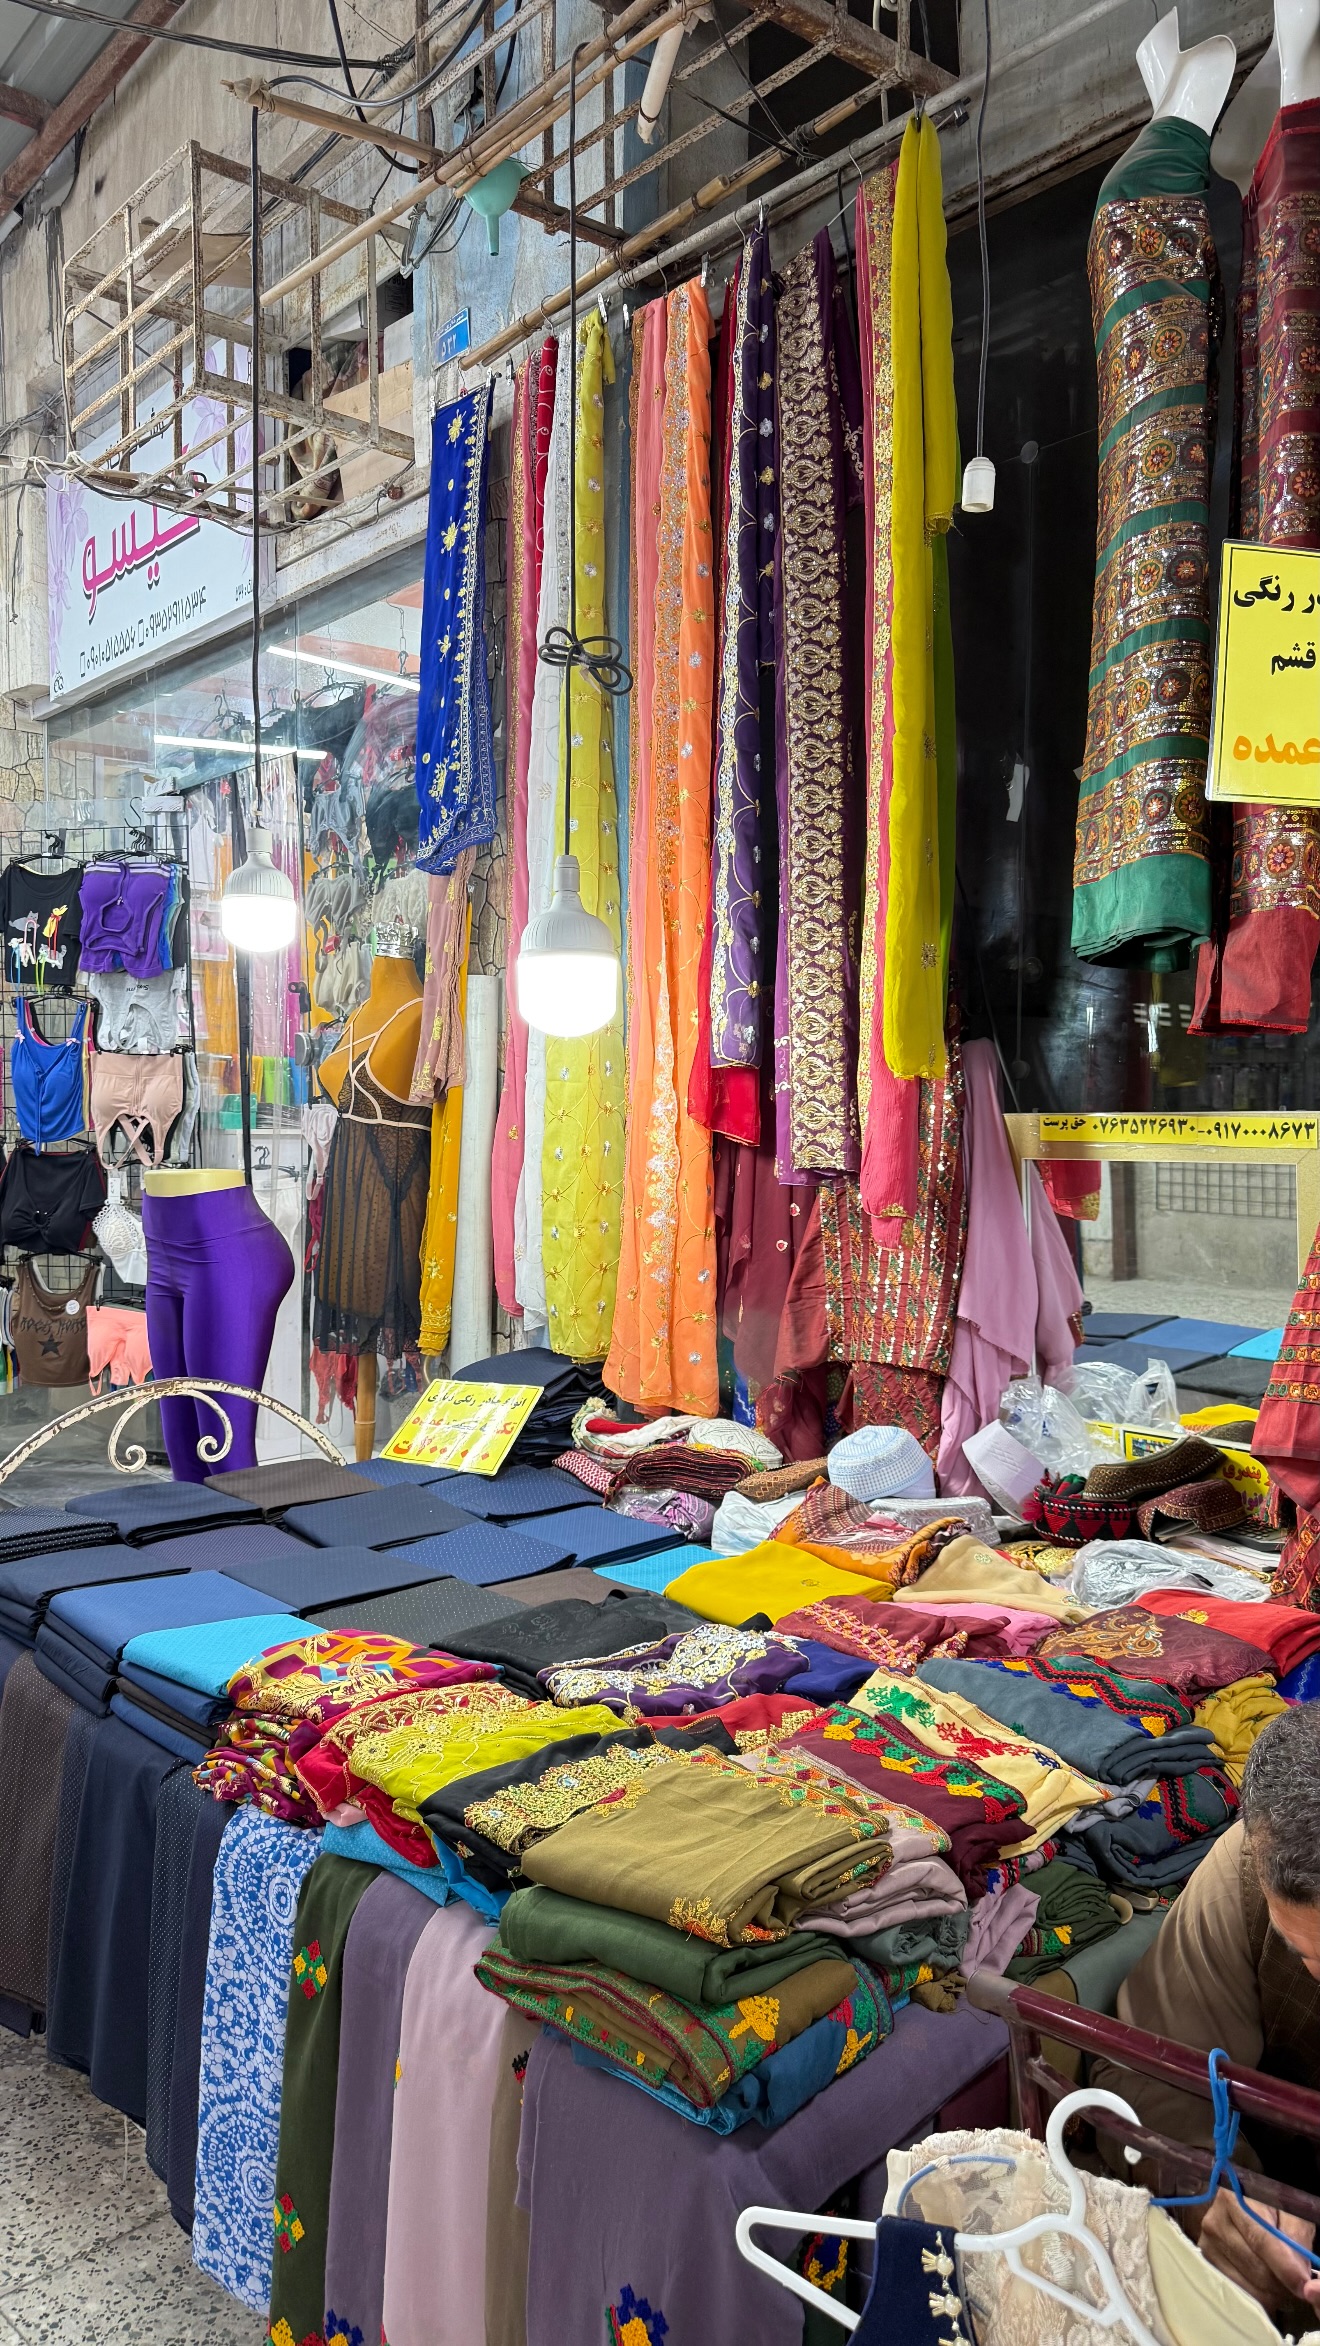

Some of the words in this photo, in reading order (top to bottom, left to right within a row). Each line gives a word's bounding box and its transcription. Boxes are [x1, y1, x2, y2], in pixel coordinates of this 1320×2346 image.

[1233, 574, 1295, 612] رنگی
[1270, 641, 1317, 676] قشم
[1232, 732, 1320, 766] عمده
[1042, 1117, 1068, 1131] پرست
[1070, 1116, 1087, 1130] حق
[1222, 1464, 1262, 1484] بندری
[1241, 1490, 1264, 1512] انوا
